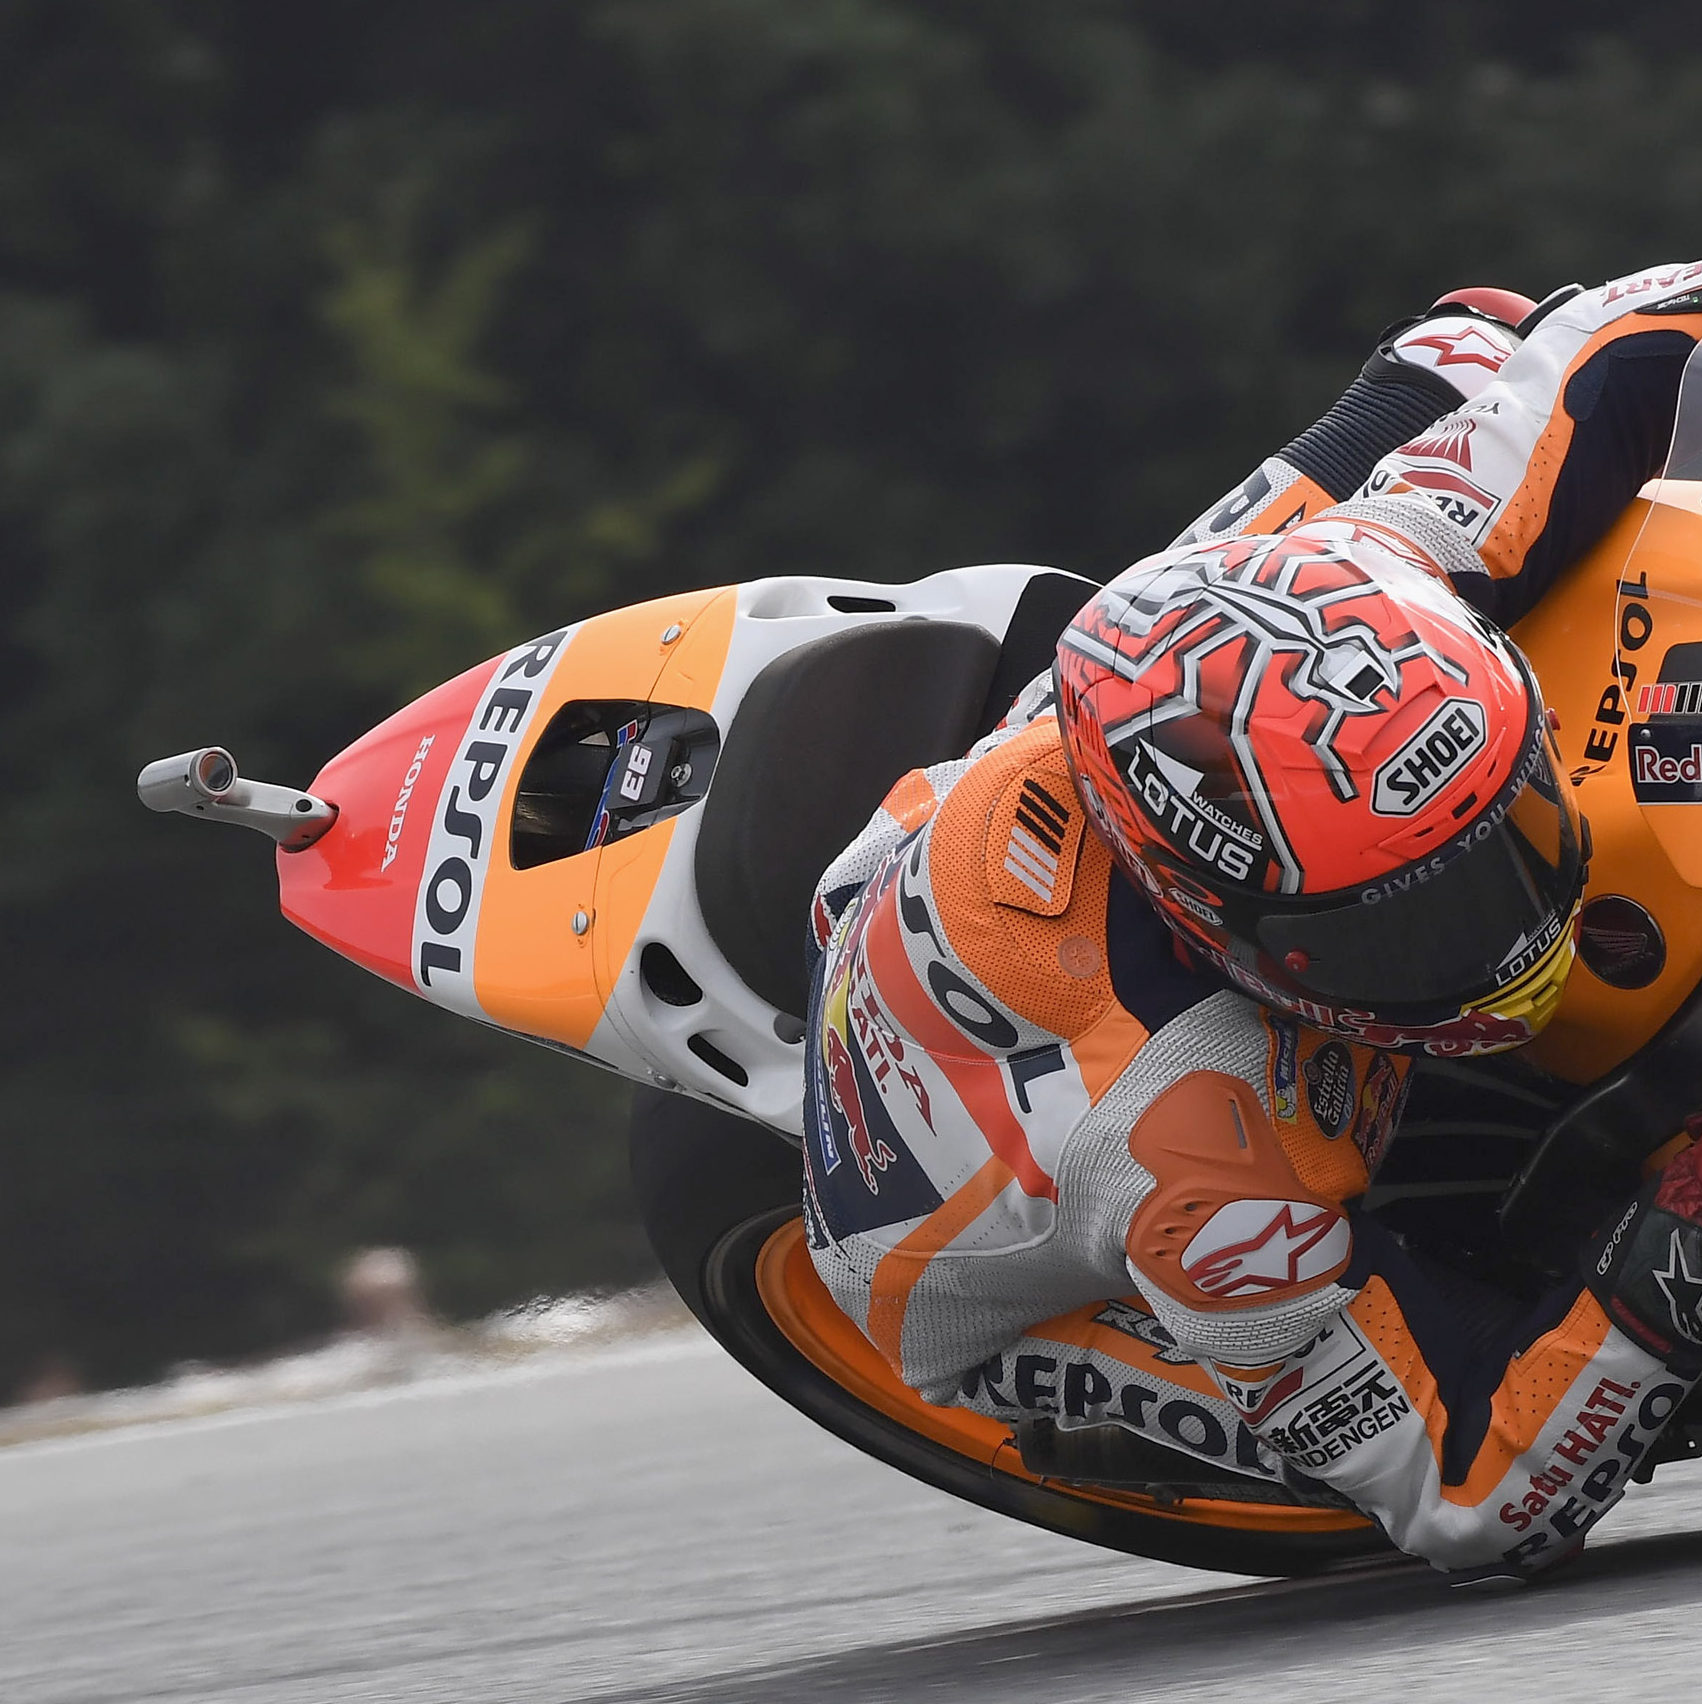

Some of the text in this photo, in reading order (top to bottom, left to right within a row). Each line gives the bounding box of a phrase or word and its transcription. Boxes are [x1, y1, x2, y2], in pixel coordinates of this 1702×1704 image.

[381, 734, 436, 873] HONDA
[619, 744, 653, 801] 93
[1386, 707, 1480, 806] SHOEI
[420, 630, 567, 989] REPSOL
[1127, 745, 1254, 881] LOTUS
[1193, 791, 1263, 845] WATCHES
[1361, 857, 1445, 905] GIVES
[1457, 803, 1506, 853] YOU
[1495, 917, 1562, 987] LOTUS
[1313, 1050, 1340, 1120] Estrella
[1327, 1065, 1350, 1126] Galicia
[1500, 1377, 1641, 1533] Satu HATI.
[1502, 1383, 1685, 1563] REPSO
